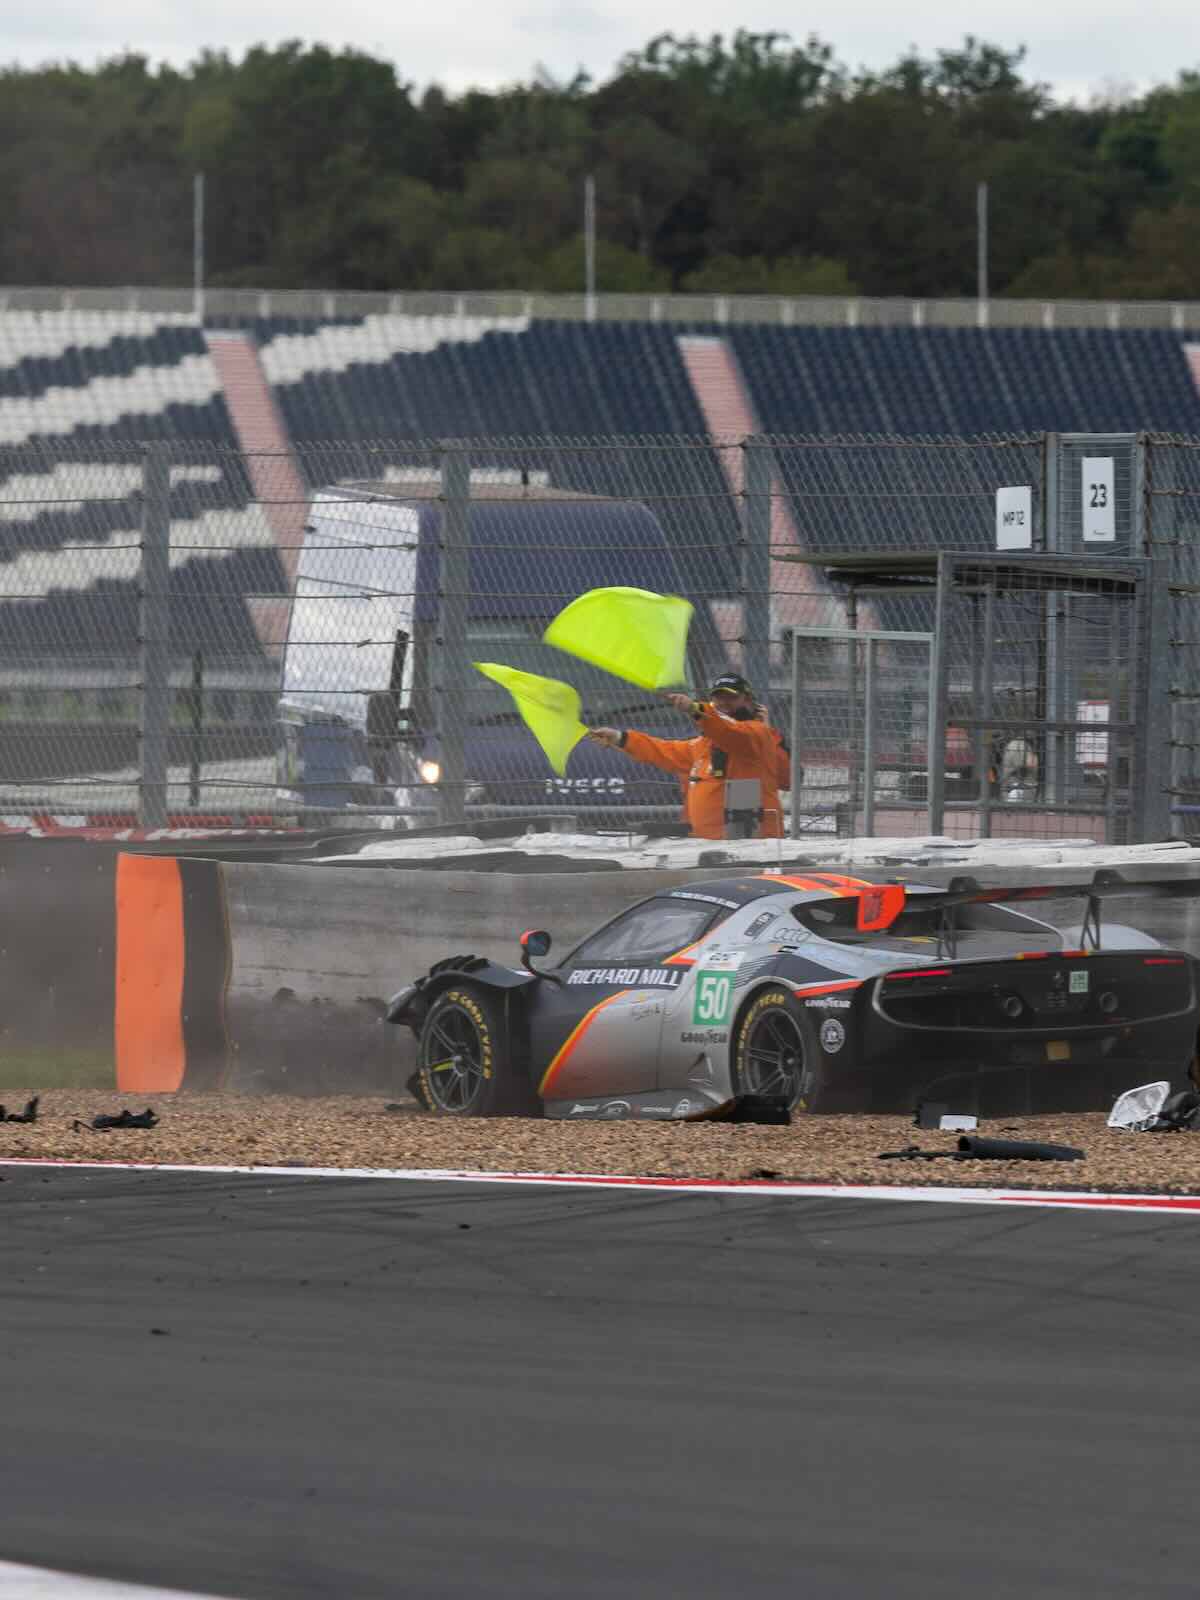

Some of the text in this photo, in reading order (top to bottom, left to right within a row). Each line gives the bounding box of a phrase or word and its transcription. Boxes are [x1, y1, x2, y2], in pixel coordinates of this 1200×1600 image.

[1090, 483, 1107, 508] 23
[543, 778, 624, 794] IVECO
[567, 968, 640, 985] RICHARD
[698, 976, 729, 1021] 50
